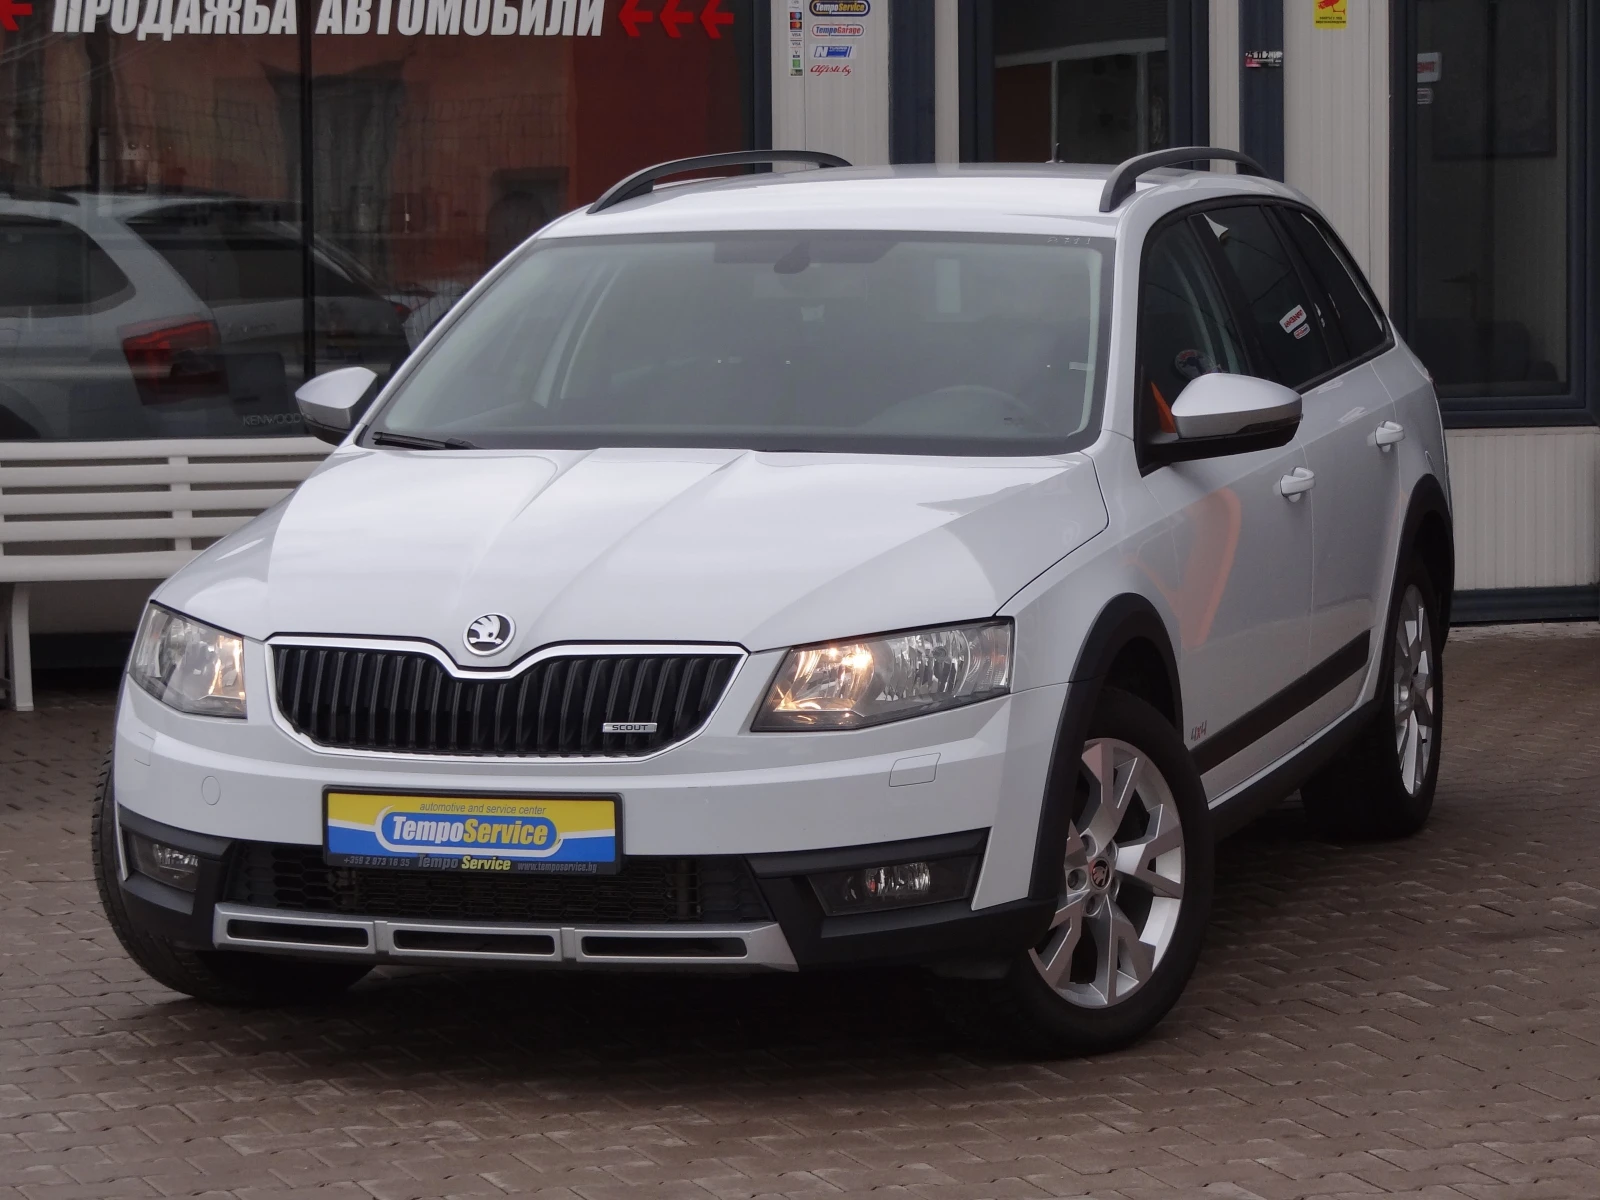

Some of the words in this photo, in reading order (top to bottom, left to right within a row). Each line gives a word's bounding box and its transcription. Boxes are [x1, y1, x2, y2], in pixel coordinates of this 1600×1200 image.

[816, 3, 865, 14] TempoService
[51, 0, 299, 41] ПРОДАЖБА
[314, 0, 604, 36] АВТОМОБИЛИ
[816, 26, 861, 36] TempoGarage
[242, 413, 301, 426] KENWOOD
[419, 802, 466, 813] automotive
[467, 804, 484, 813] and
[485, 805, 517, 814] service
[518, 806, 547, 815] center
[392, 816, 549, 845] TempoService
[365, 857, 371, 865] 2
[400, 858, 410, 867] 35
[417, 853, 458, 870] Tempo
[461, 855, 511, 871] Service
[517, 862, 598, 873] www.temposervice.bg
